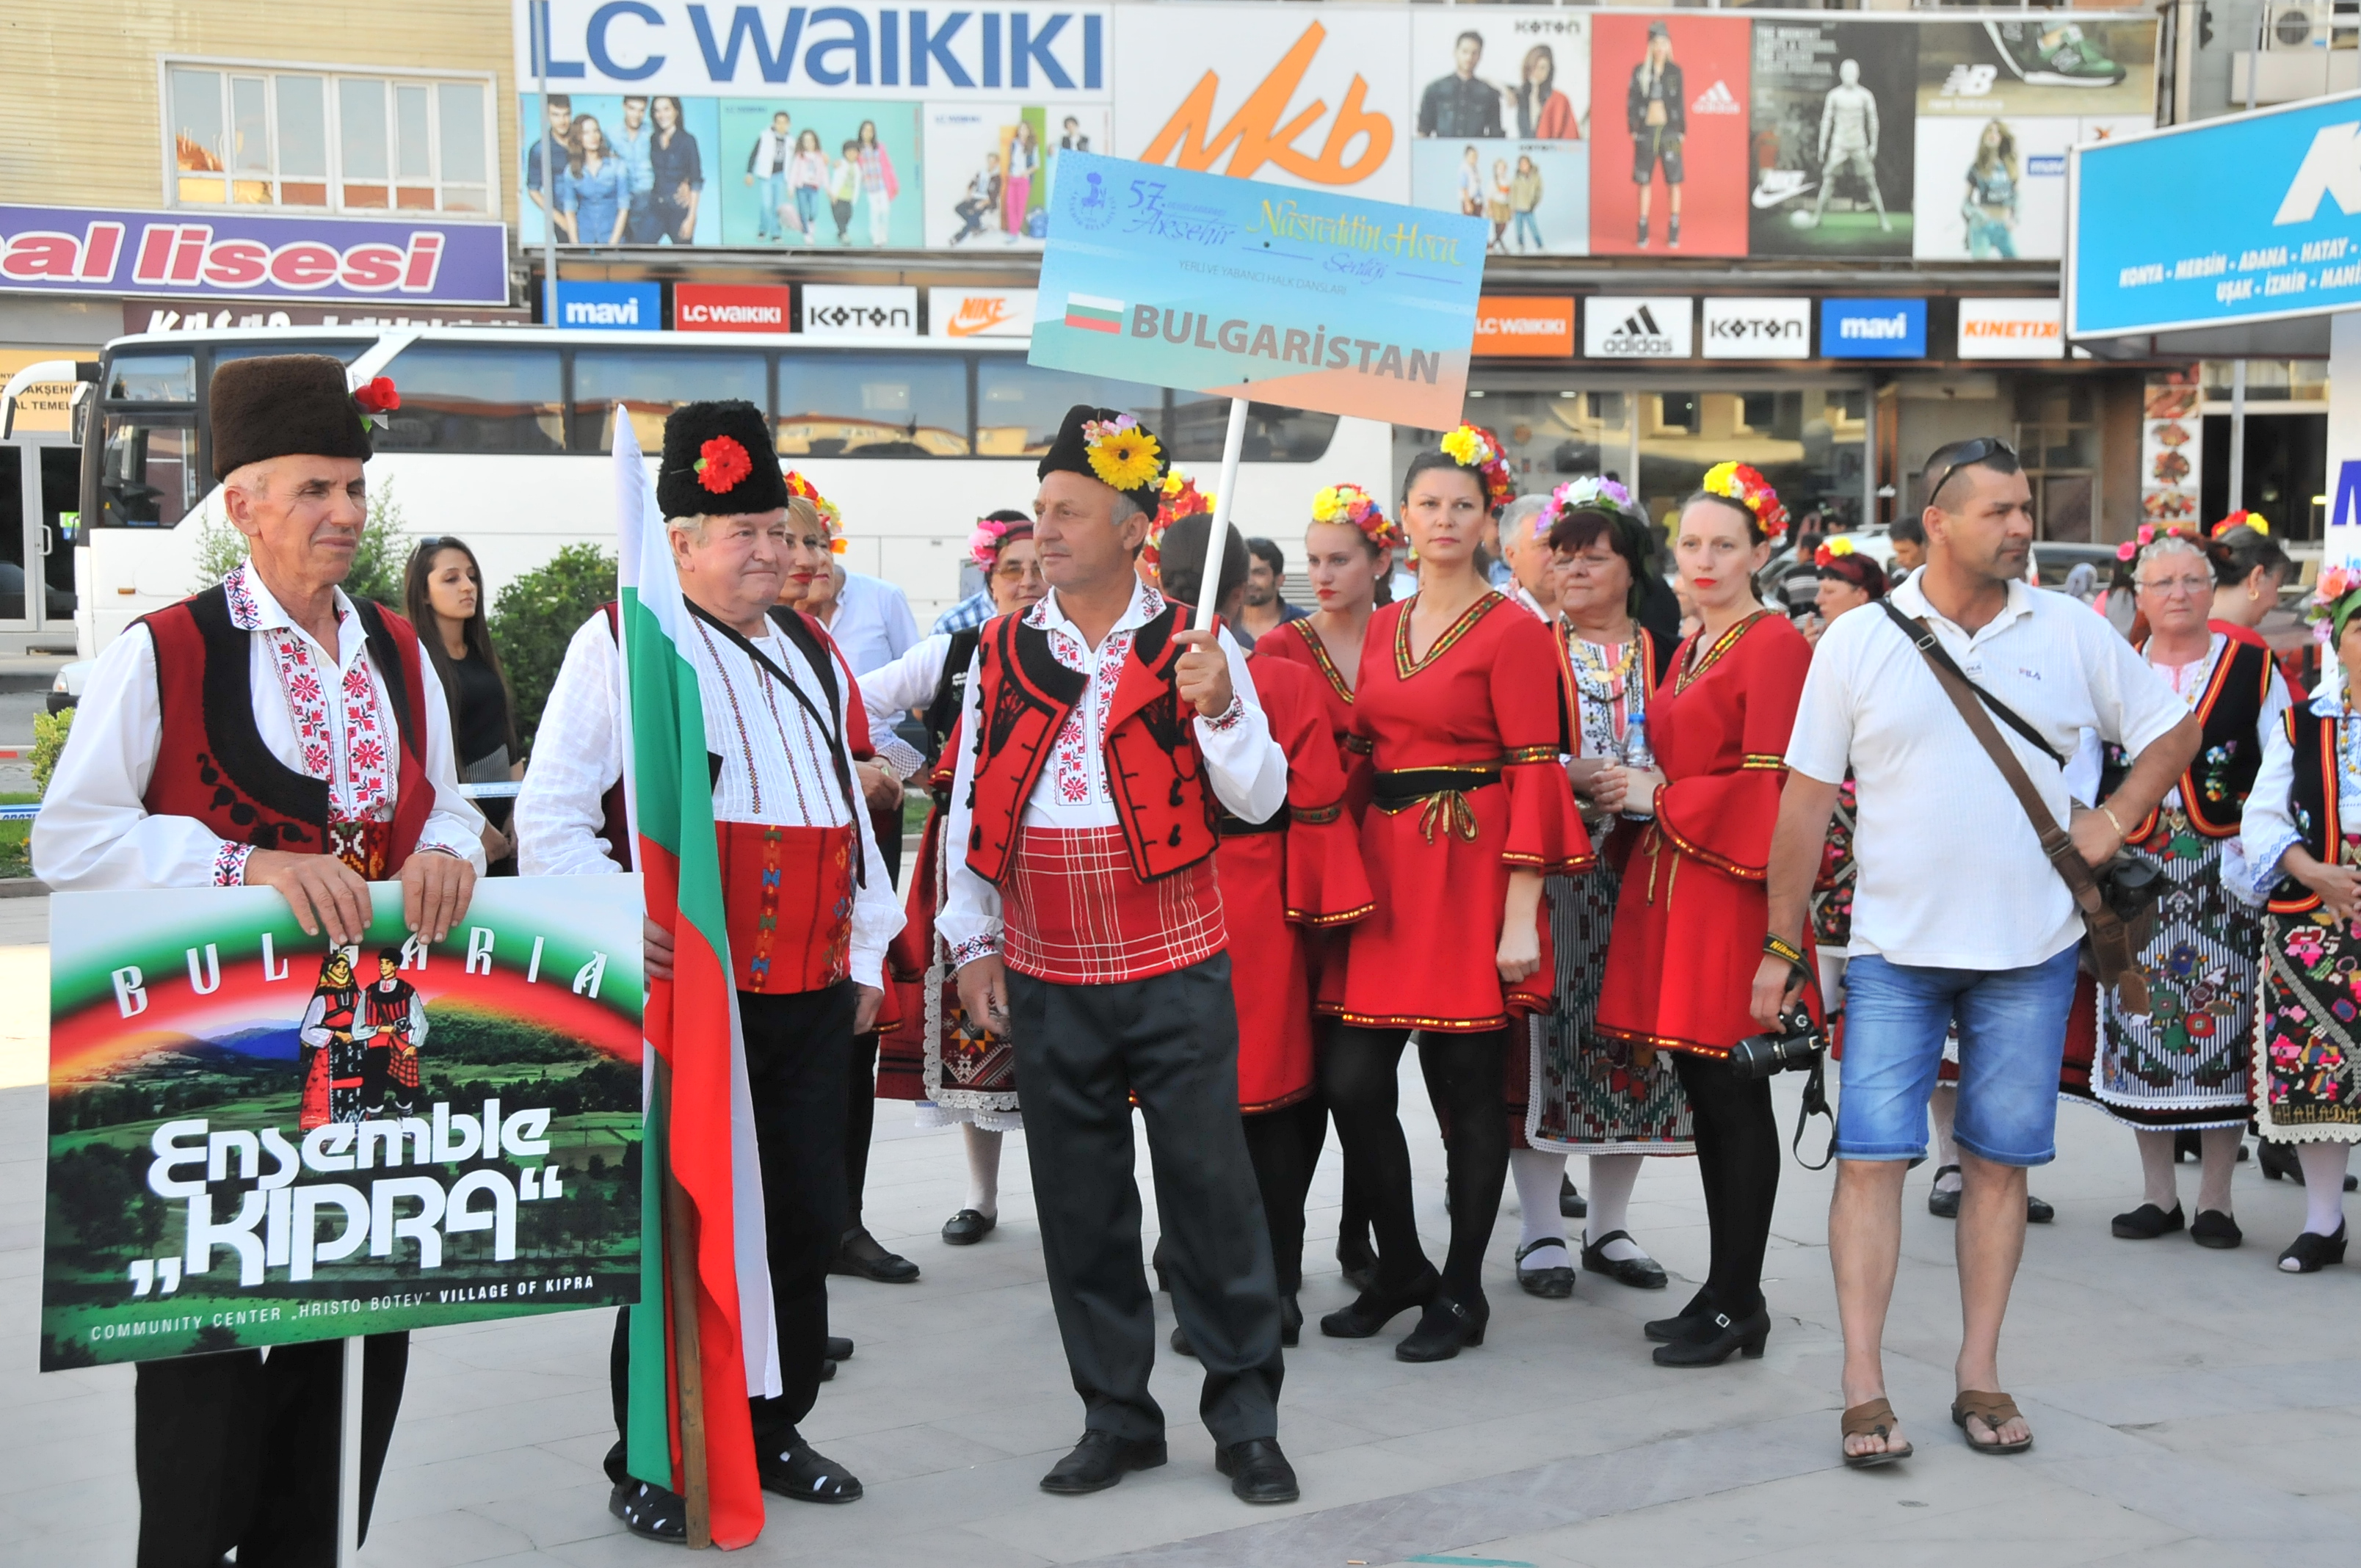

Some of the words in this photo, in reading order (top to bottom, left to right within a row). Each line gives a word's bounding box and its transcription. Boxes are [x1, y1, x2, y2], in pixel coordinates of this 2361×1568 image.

[531, 0, 665, 81] LC
[0, 221, 126, 283] al
[133, 223, 444, 291] lisesi
[2119, 263, 2164, 288] KONYA
[2238, 245, 2288, 272] ADANA
[958, 297, 1007, 321] NIKE
[2216, 277, 2253, 306] UŞAK
[566, 298, 637, 324] mavi
[1840, 313, 1907, 339] mavi
[1131, 303, 1441, 385] BULGARİSTAN
[1603, 337, 1672, 354] adidas
[90, 1315, 203, 1340] COMMUNITY
[213, 1307, 281, 1328] CENTER
[440, 1283, 508, 1304] VILLAGE
[517, 1280, 537, 1296] OF
[545, 1274, 594, 1293] KIPRA
